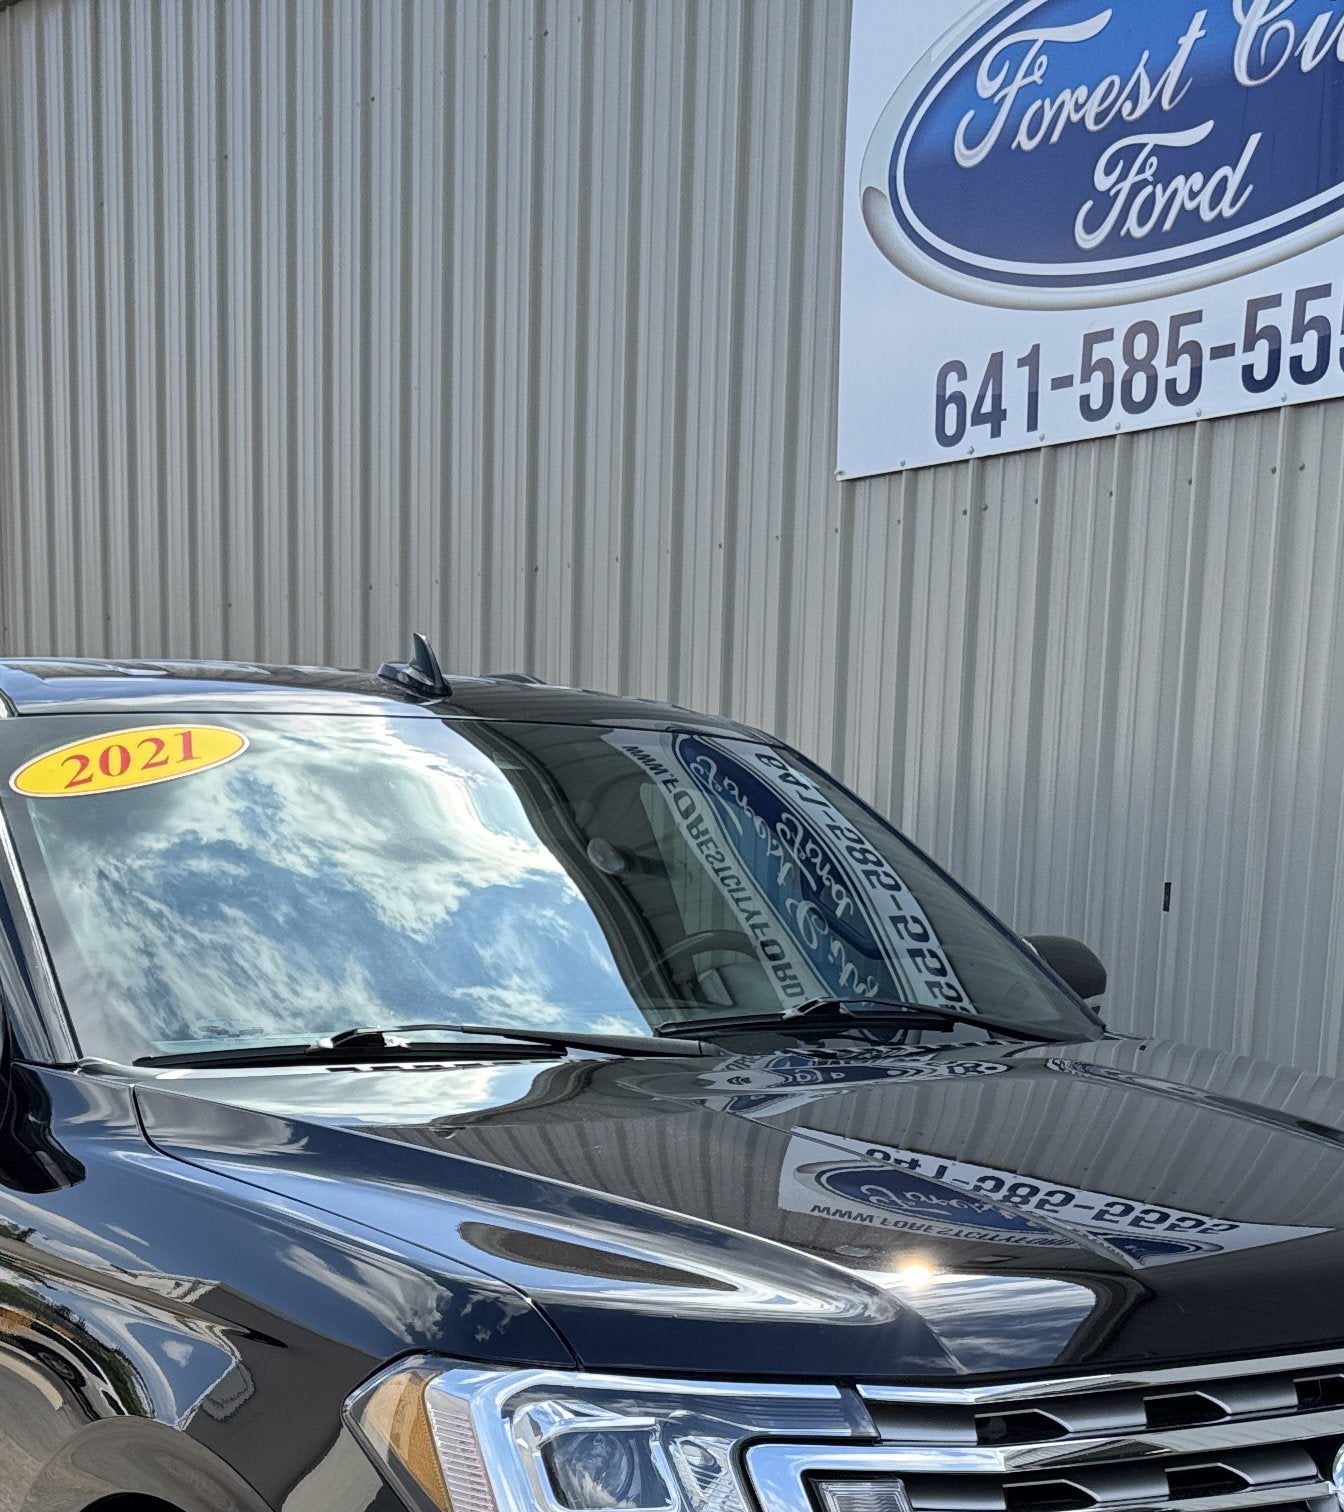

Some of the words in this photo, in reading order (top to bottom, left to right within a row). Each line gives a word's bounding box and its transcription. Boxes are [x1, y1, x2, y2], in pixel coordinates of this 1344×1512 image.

[953, 8, 1208, 168] Forest
[1073, 119, 1262, 250] Ford
[60, 730, 202, 789] 2021
